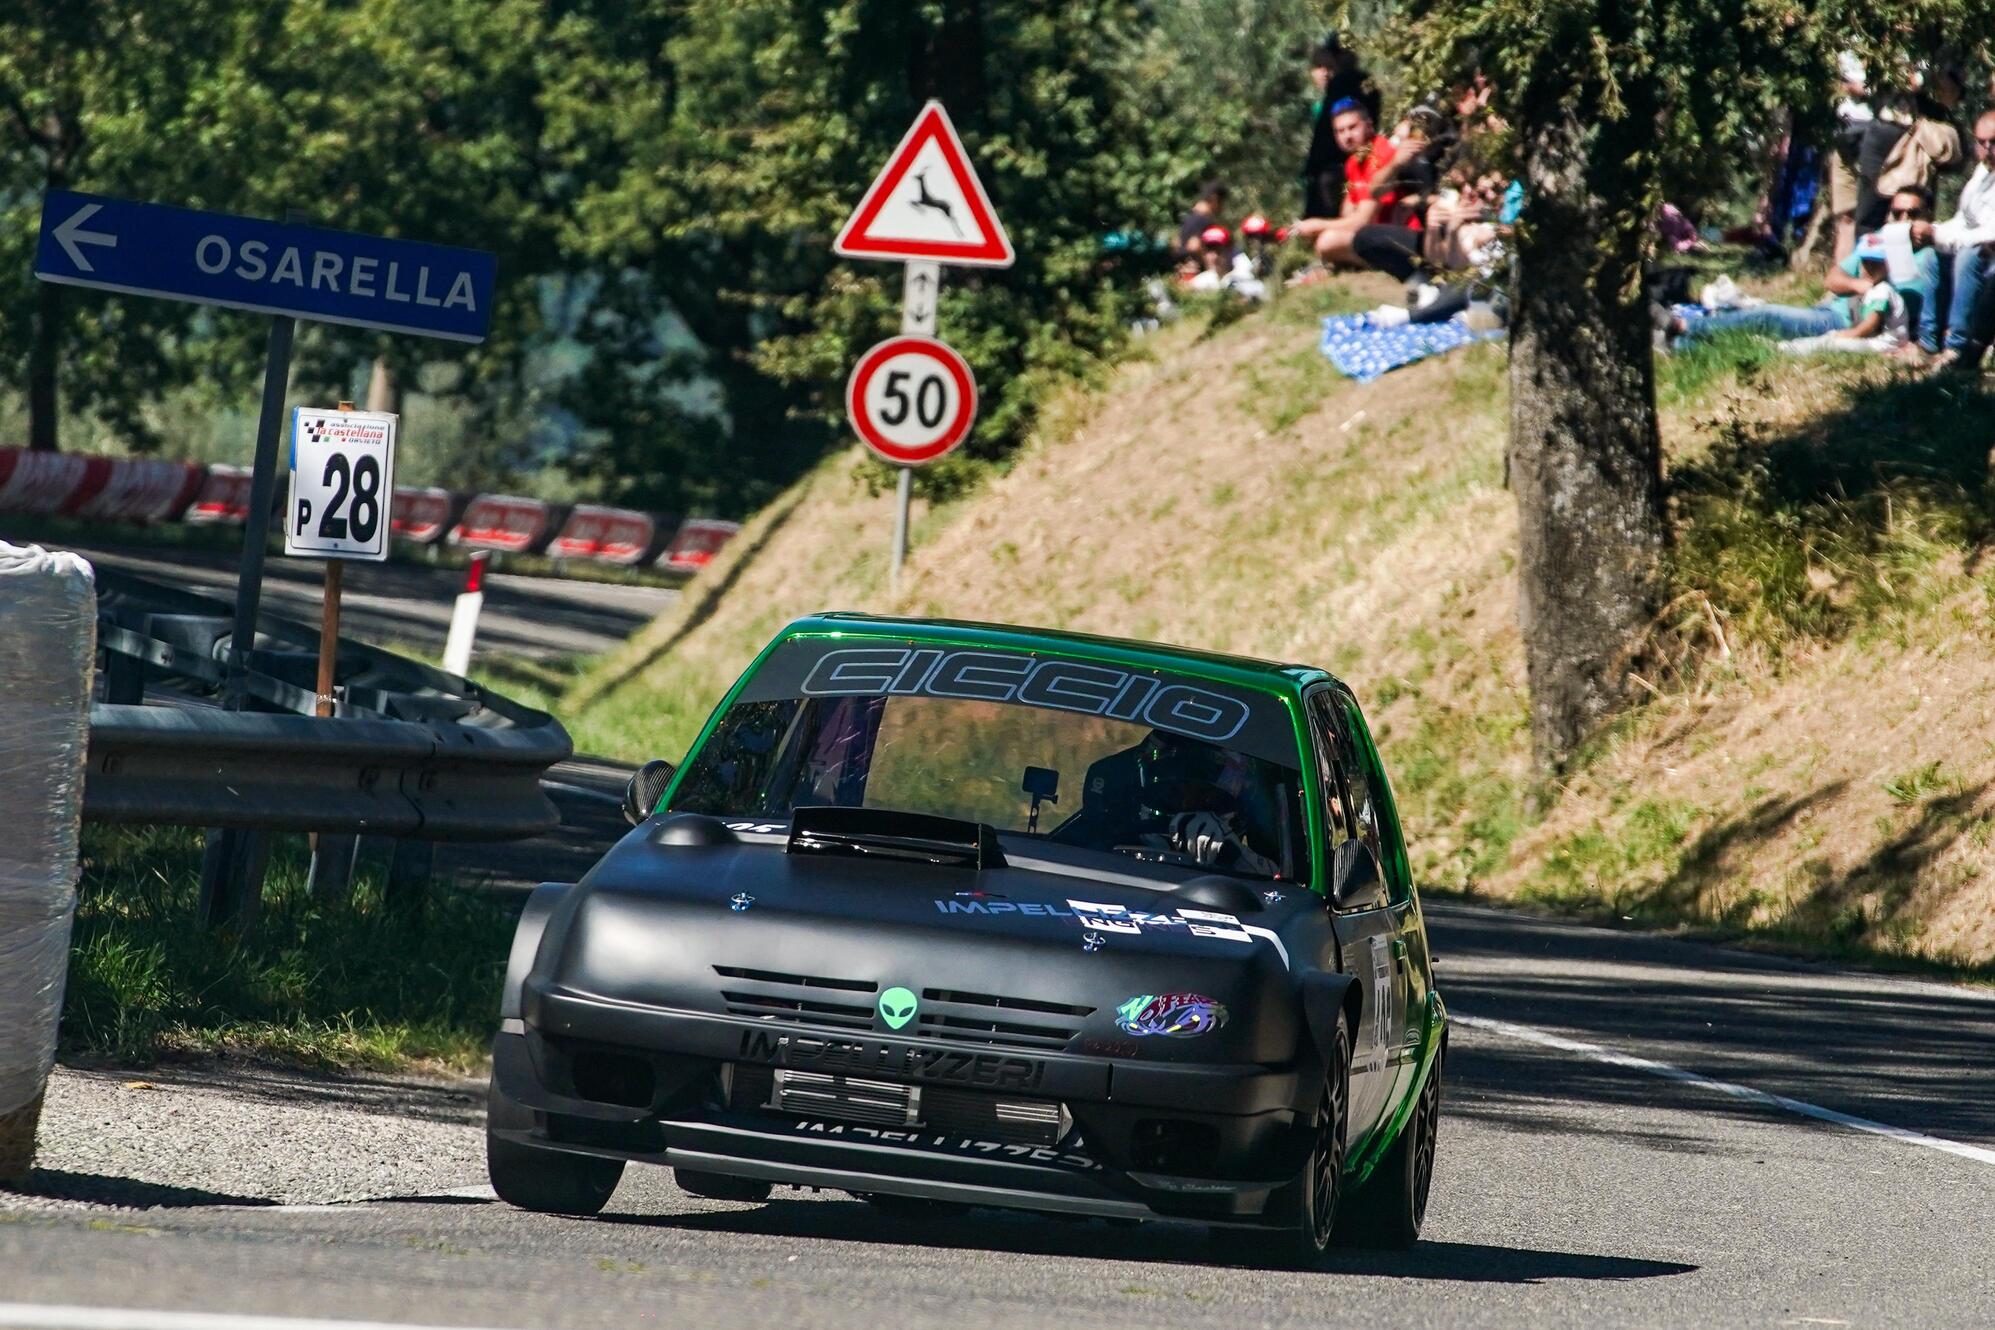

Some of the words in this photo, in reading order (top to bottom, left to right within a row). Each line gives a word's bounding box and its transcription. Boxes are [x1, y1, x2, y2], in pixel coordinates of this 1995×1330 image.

[195, 234, 477, 312] OSARELLA
[317, 426, 326, 435] la
[328, 427, 384, 439] castellana
[880, 370, 947, 429] 50
[296, 498, 312, 536] P
[318, 452, 380, 543] 28
[800, 648, 1250, 741] CICCIO
